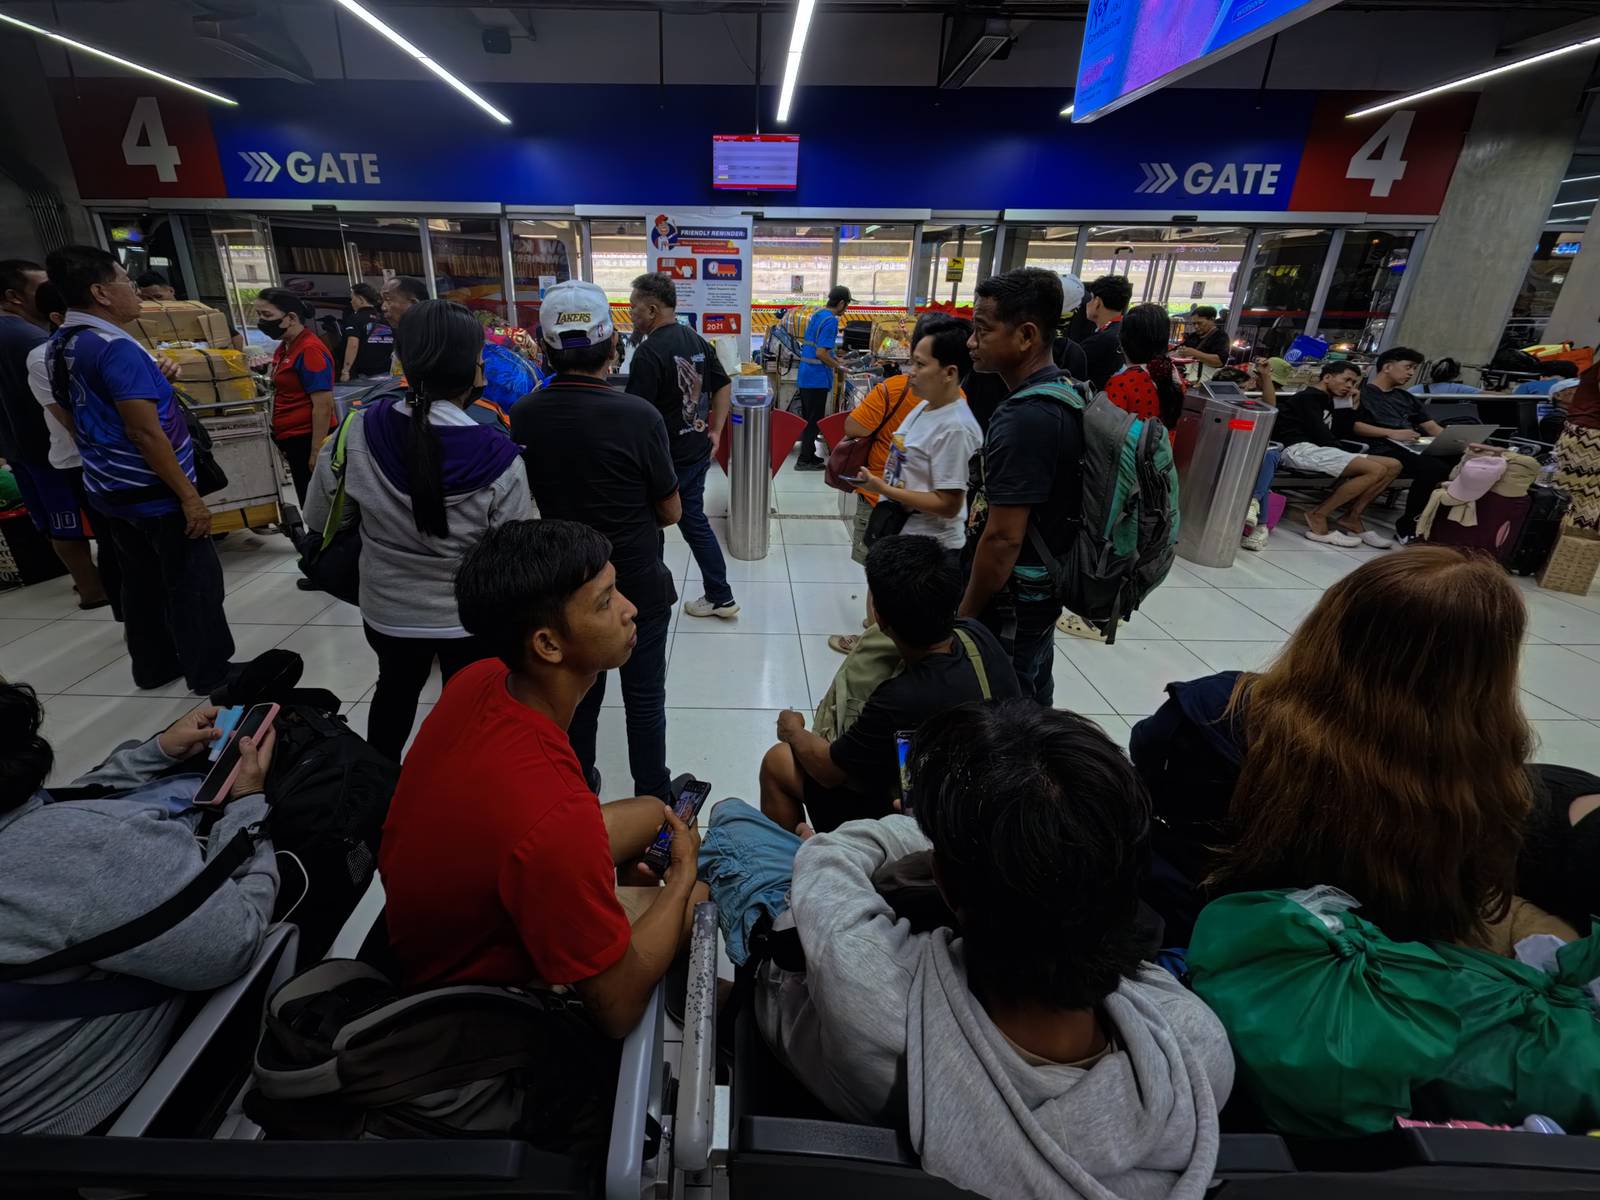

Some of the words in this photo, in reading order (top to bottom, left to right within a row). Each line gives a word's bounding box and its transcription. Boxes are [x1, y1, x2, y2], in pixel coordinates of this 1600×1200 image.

[121, 97, 182, 183] 4
[286, 152, 381, 183] GATE
[1183, 163, 1281, 195] GATE
[1345, 111, 1416, 197] 4
[555, 311, 592, 326] LAKERS
